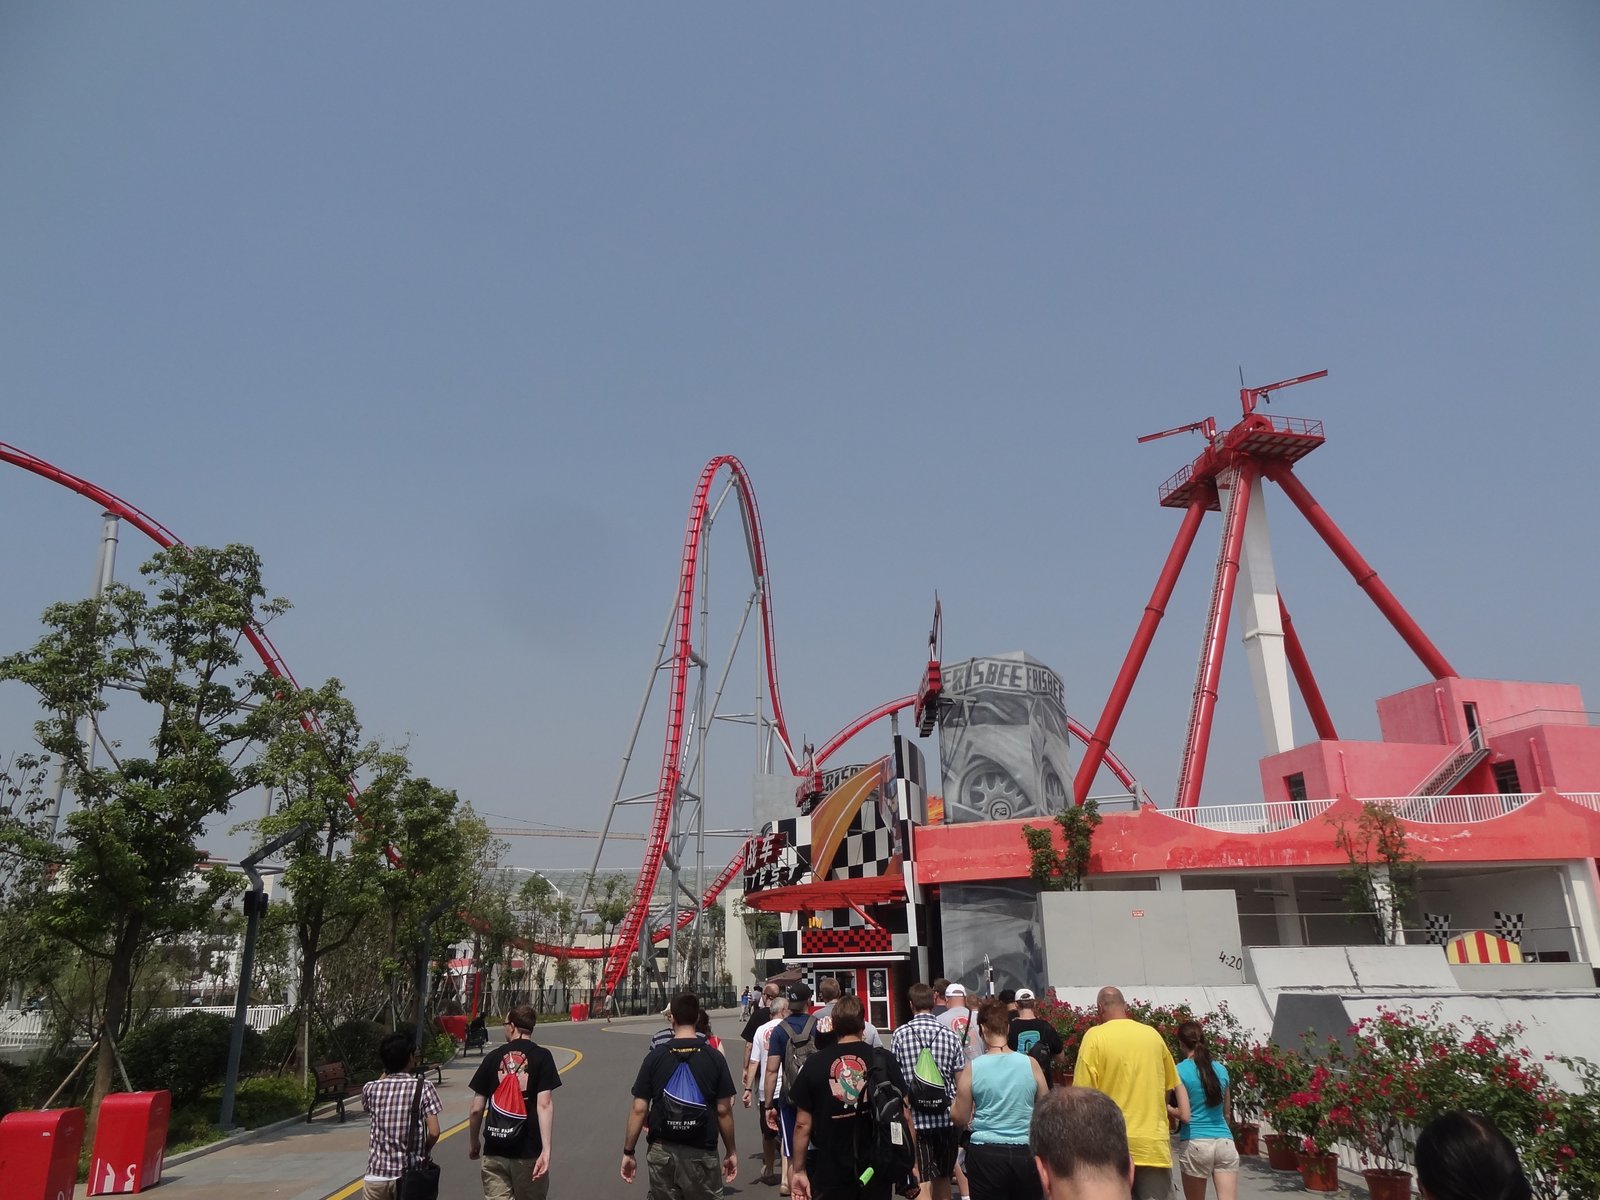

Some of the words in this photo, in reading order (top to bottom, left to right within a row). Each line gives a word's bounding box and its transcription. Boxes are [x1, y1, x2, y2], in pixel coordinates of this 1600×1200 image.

[942, 662, 1023, 691] FRISBEE
[1026, 667, 1065, 707] FRISBEE
[752, 863, 800, 889] TEST
[1218, 950, 1243, 971] 4:20
